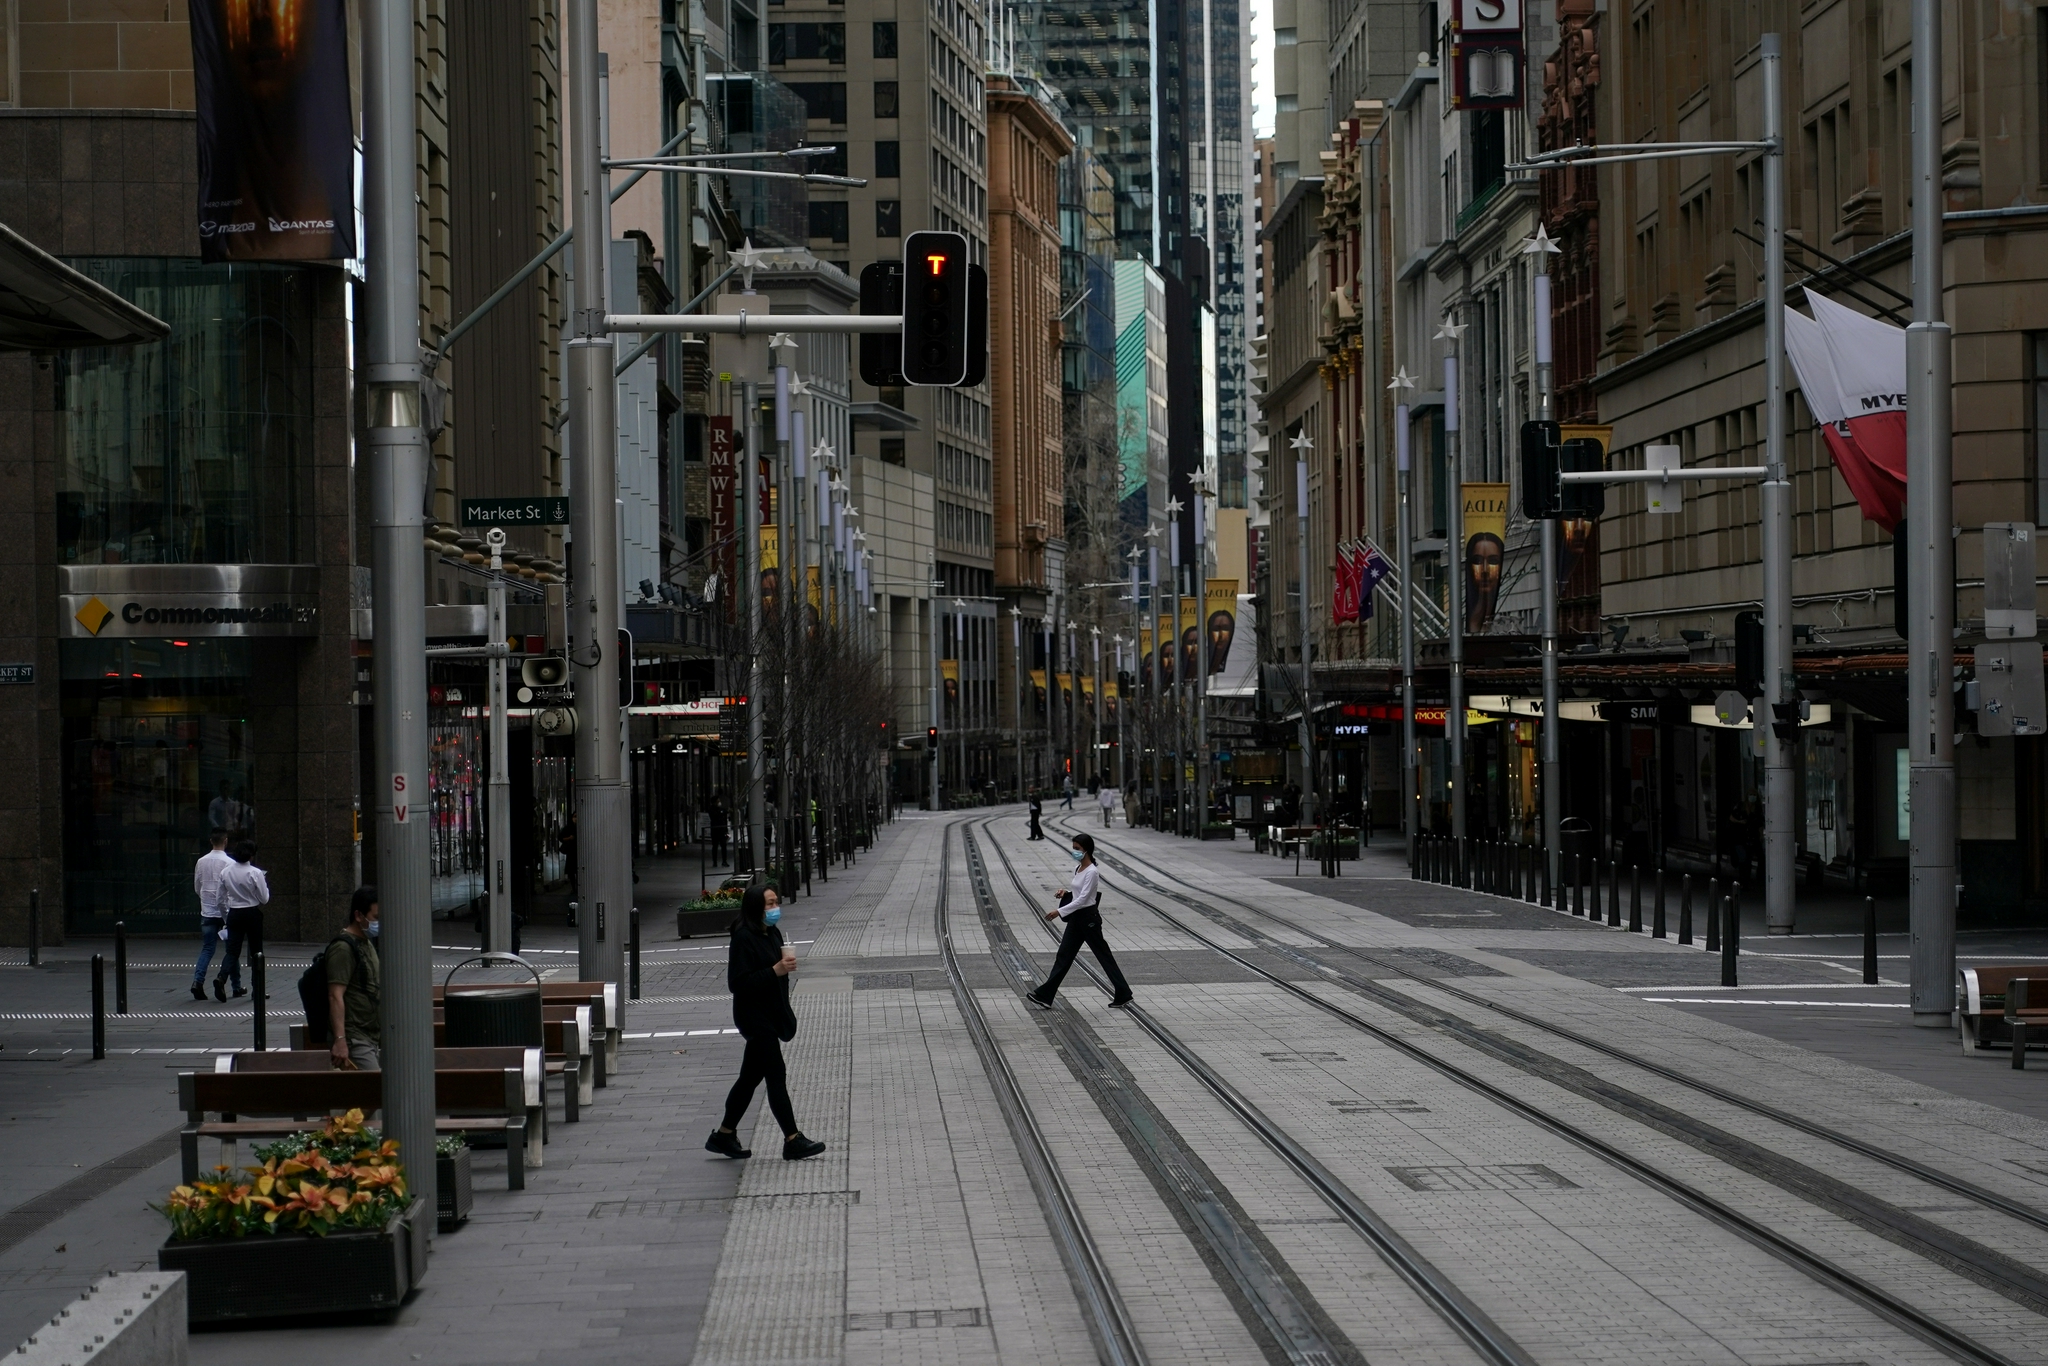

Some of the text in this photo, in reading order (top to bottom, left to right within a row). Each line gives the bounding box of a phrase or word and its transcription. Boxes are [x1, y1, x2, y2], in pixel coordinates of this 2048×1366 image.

[279, 220, 335, 230] QANTAS
[1861, 393, 1907, 410] MYE
[468, 504, 541, 521] Market St
[122, 602, 294, 625] Commonwealth
[0, 667, 32, 677] KET ST
[1414, 711, 1447, 720] YMOCK
[1630, 706, 1658, 719] SAM
[1335, 725, 1369, 735] HYPE
